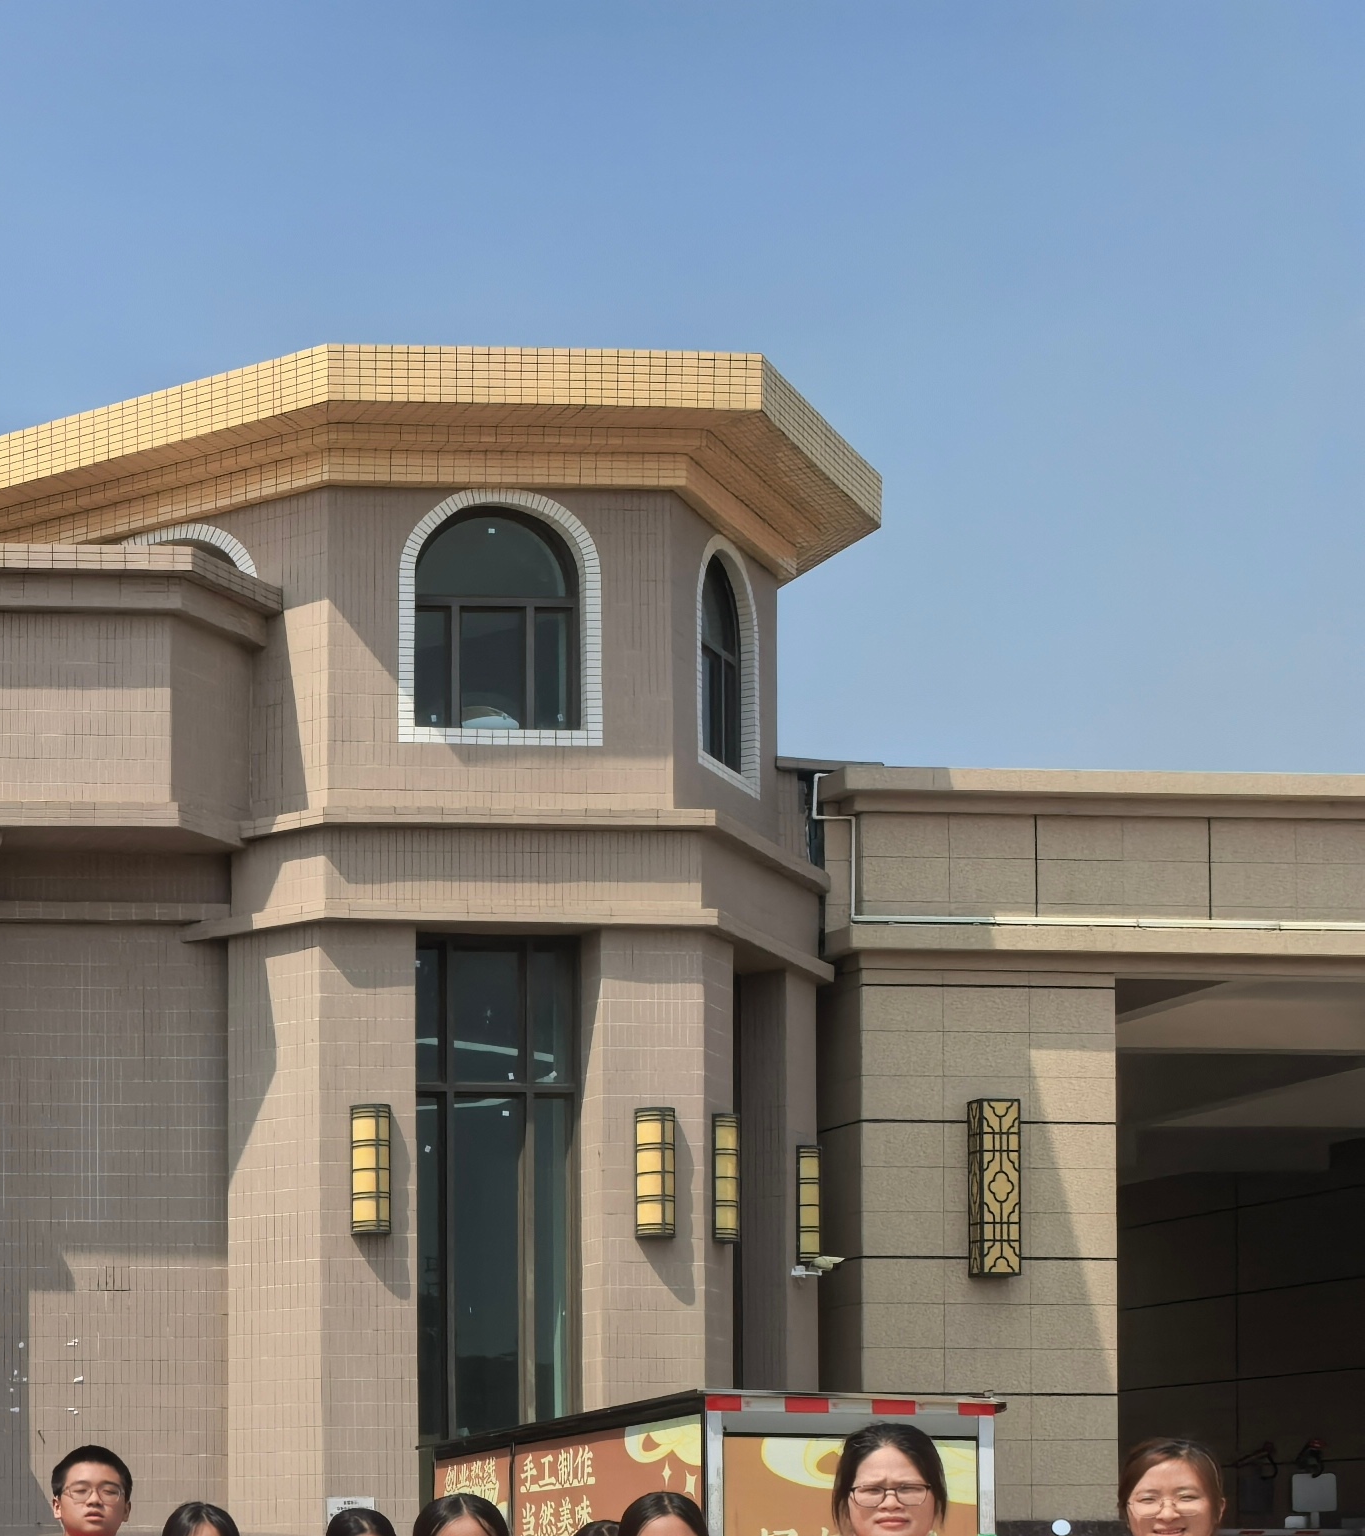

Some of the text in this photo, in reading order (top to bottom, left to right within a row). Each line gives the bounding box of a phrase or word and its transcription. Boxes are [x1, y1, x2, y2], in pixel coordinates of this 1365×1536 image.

[444, 1457, 498, 1491] 创业热线
[520, 1445, 594, 1490] 手工制作
